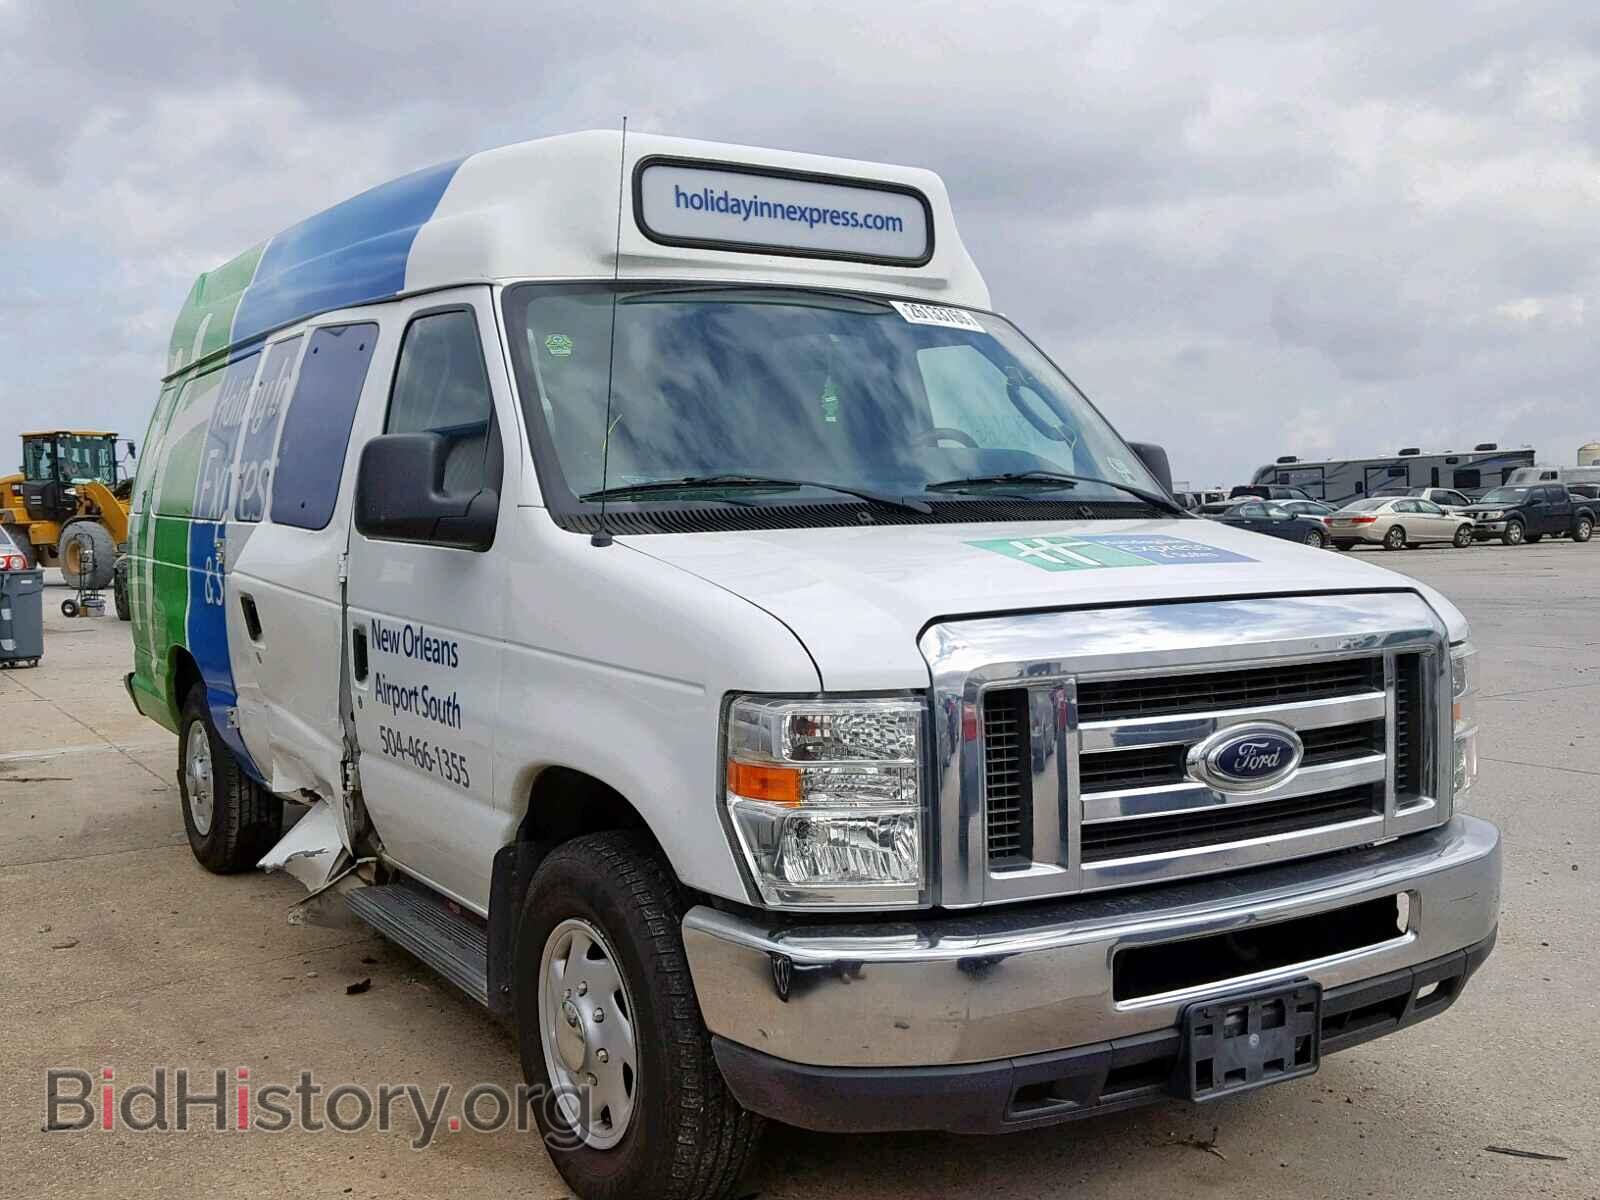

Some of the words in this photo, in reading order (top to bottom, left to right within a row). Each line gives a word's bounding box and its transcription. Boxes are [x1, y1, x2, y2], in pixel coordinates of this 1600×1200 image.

[675, 185, 904, 233] holidayinnexpress.com
[371, 618, 401, 655] New
[403, 624, 459, 669] Orleans
[375, 672, 420, 716] Airport
[421, 685, 462, 730] South
[379, 725, 470, 788] 504-466-1355
[1234, 742, 1281, 770] Ford
